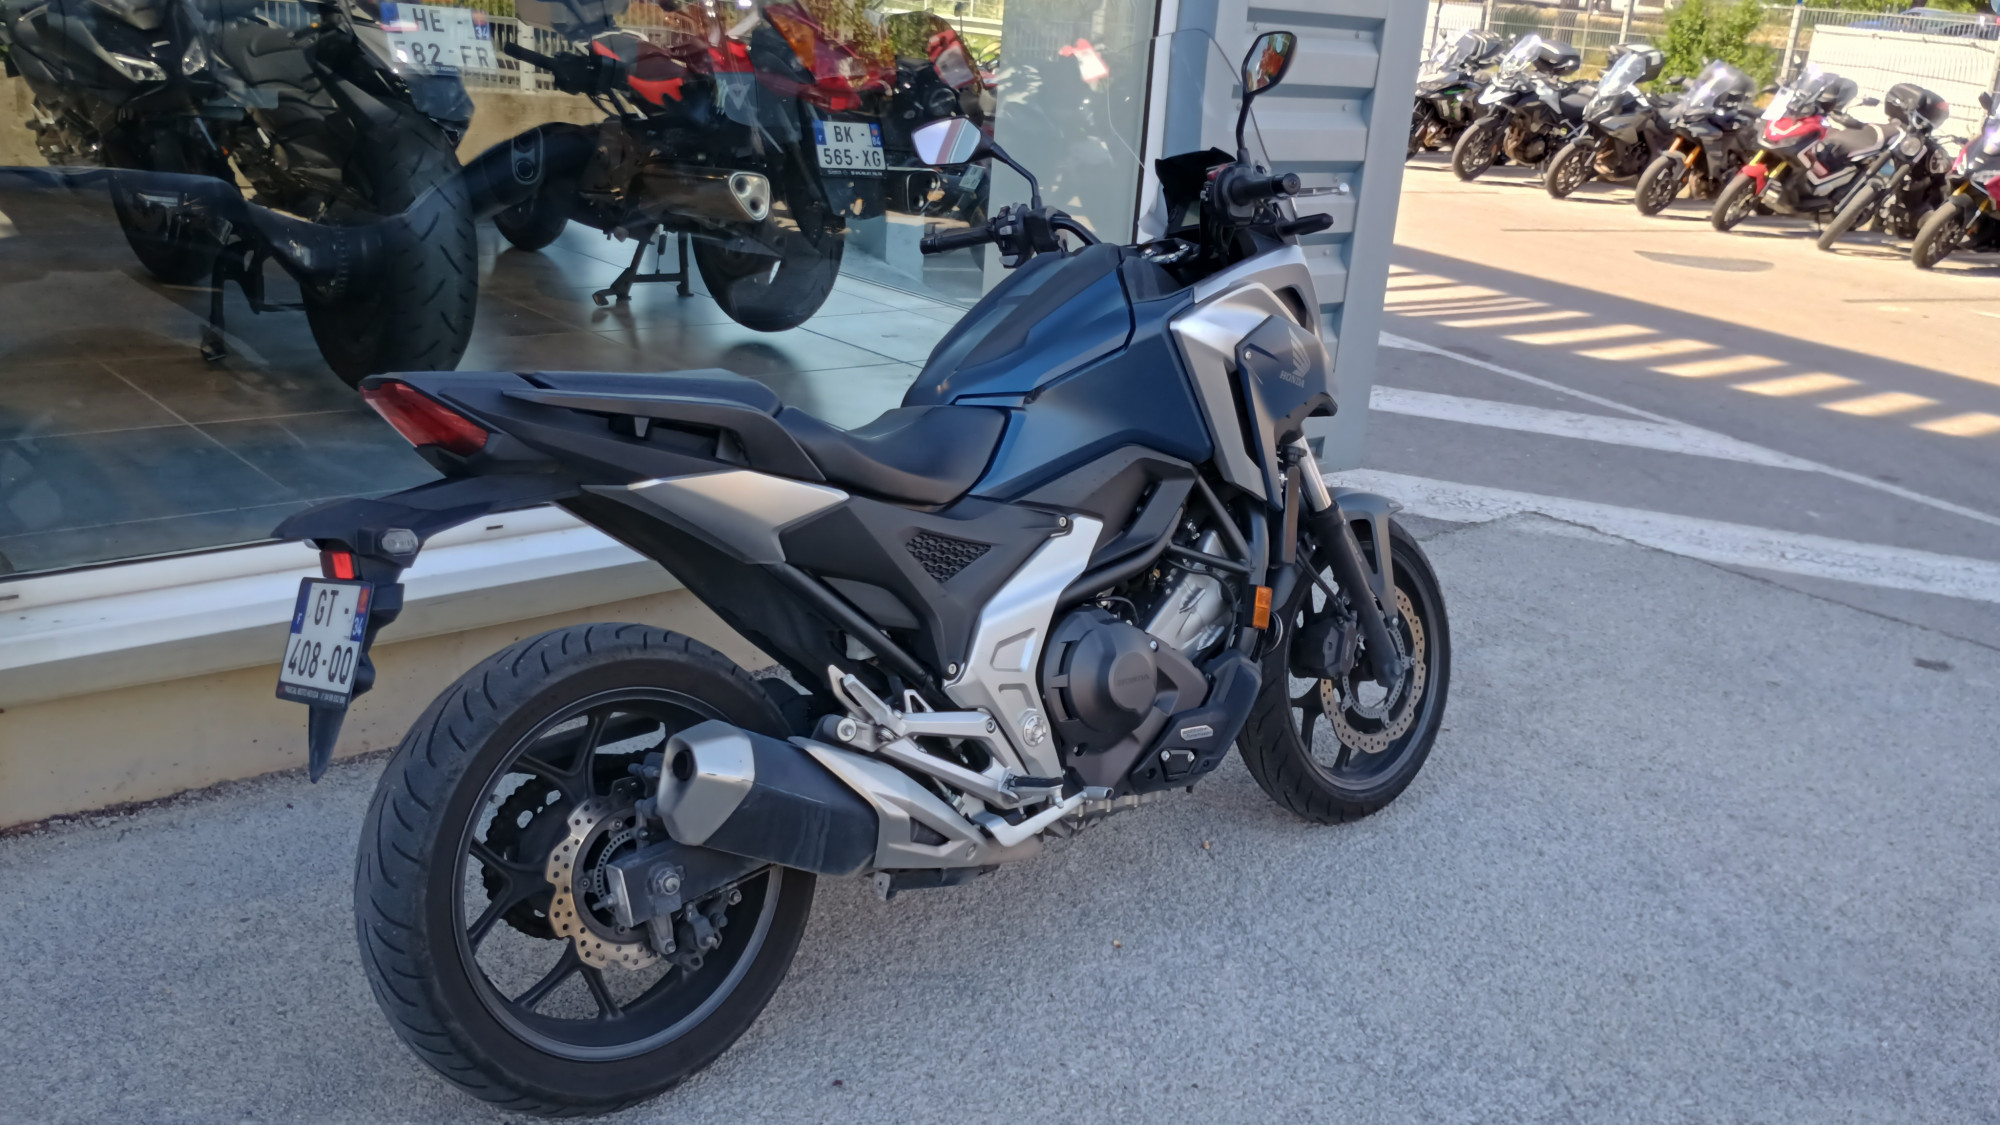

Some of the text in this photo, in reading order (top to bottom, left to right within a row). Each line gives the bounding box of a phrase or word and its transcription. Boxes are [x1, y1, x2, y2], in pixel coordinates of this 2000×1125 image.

[824, 148, 881, 167] 565-XG
[1279, 370, 1305, 388] HONDA
[352, 616, 363, 636] 34
[288, 639, 353, 684] 408-QQ
